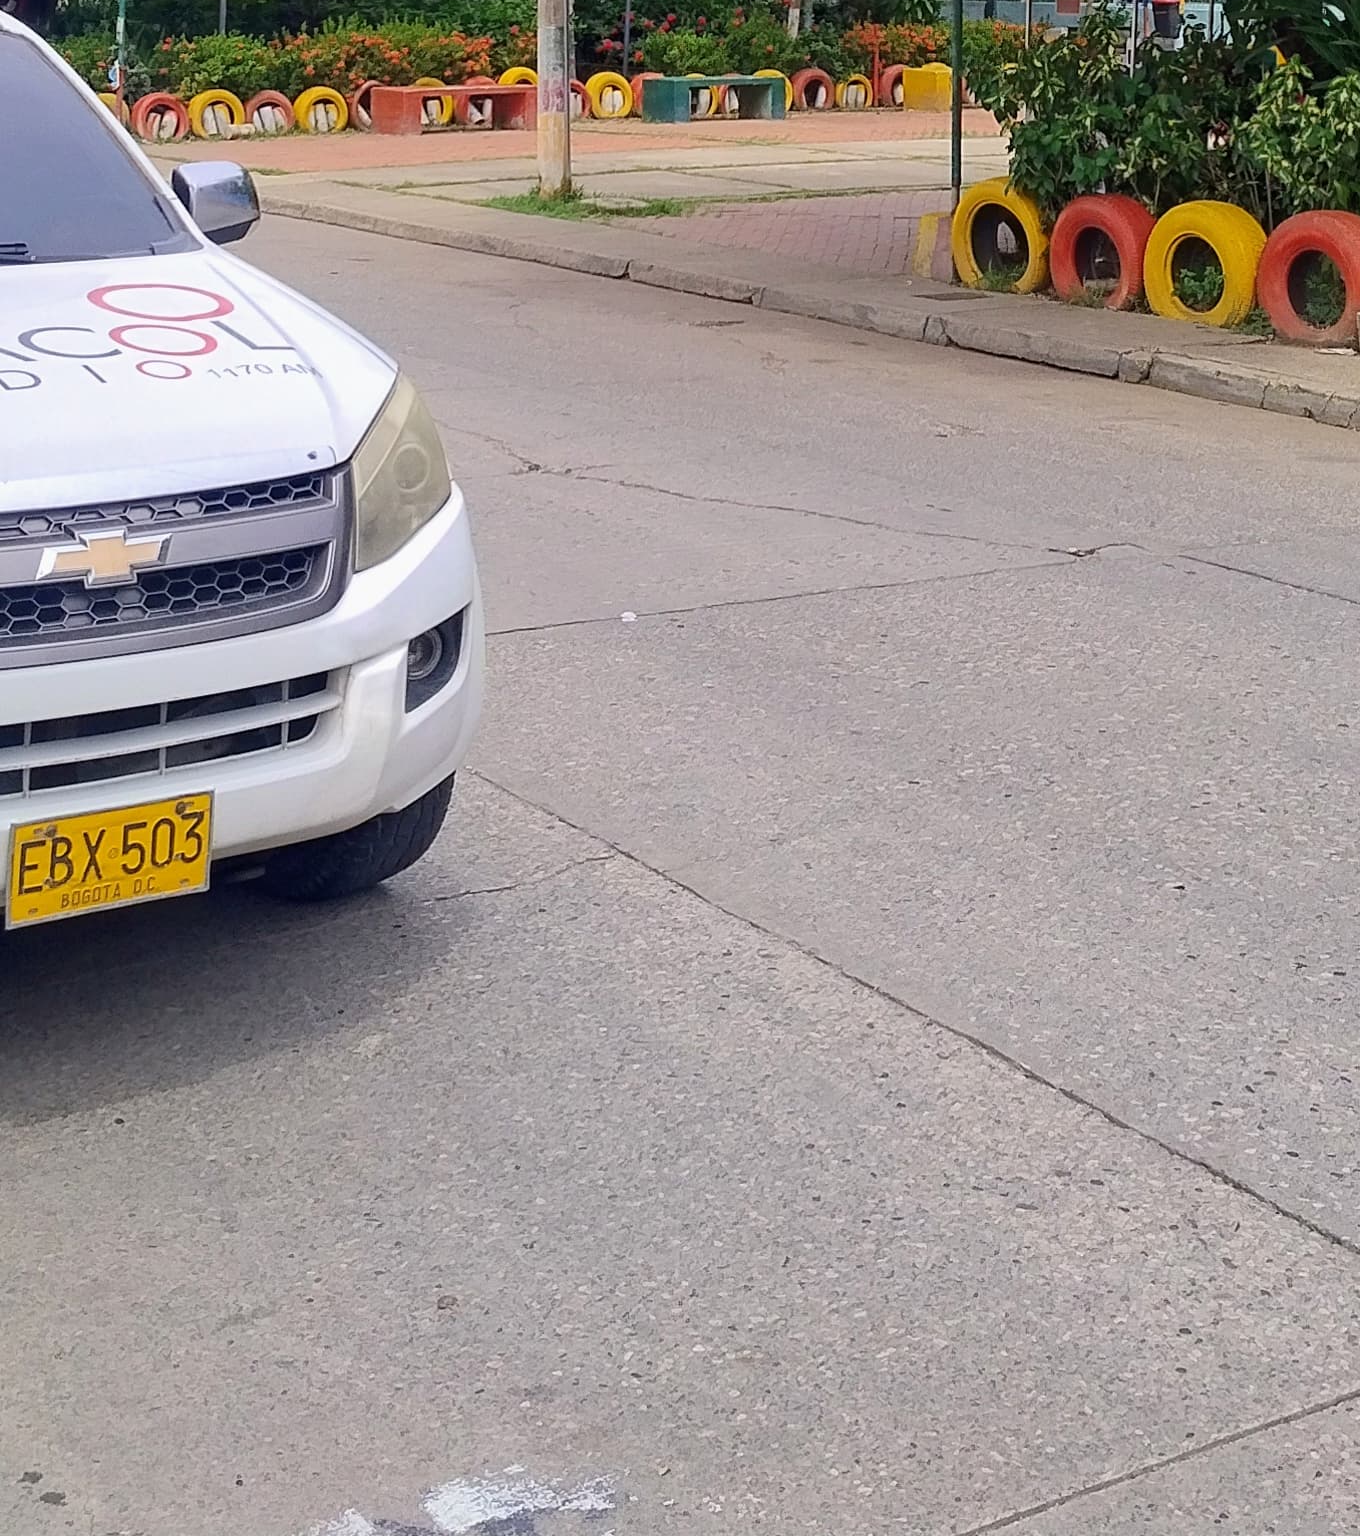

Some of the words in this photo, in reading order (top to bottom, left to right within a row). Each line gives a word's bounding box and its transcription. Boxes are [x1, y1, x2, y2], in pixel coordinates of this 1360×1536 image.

[207, 363, 274, 379] 1170
[282, 363, 324, 379] AM
[17, 828, 107, 897] EBX
[121, 810, 206, 876] 503
[60, 882, 122, 910] BOGOTA
